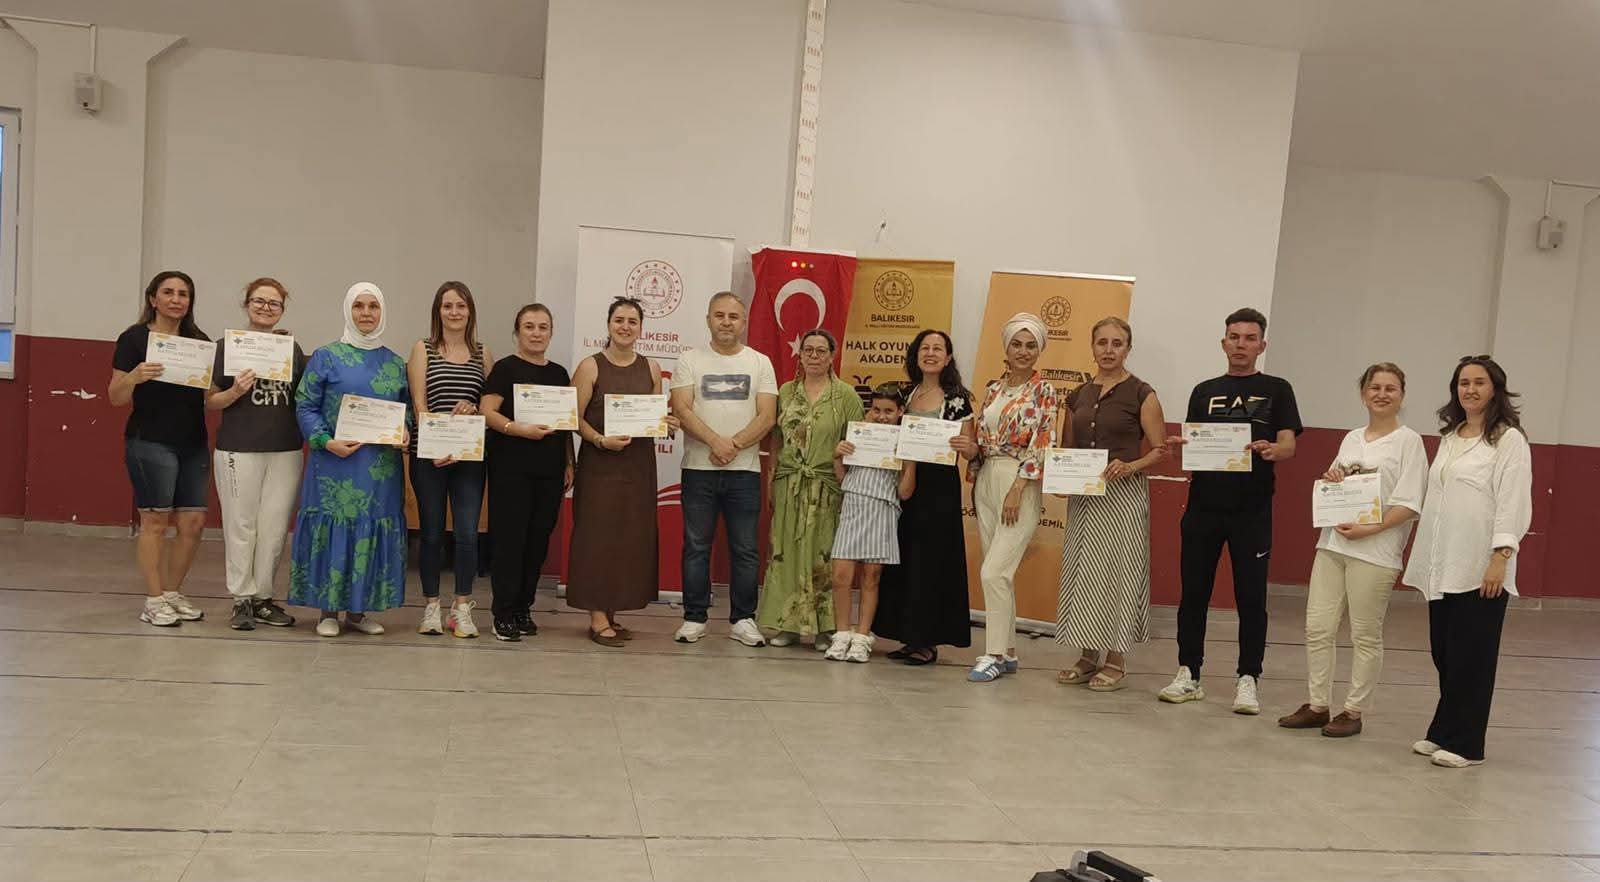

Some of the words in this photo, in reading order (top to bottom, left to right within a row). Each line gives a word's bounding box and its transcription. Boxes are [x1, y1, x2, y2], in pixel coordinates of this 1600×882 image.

[639, 330, 680, 342] LIKESİR
[846, 340, 877, 351] HALK
[879, 341, 911, 351] OYUN
[251, 389, 290, 406] CITY
